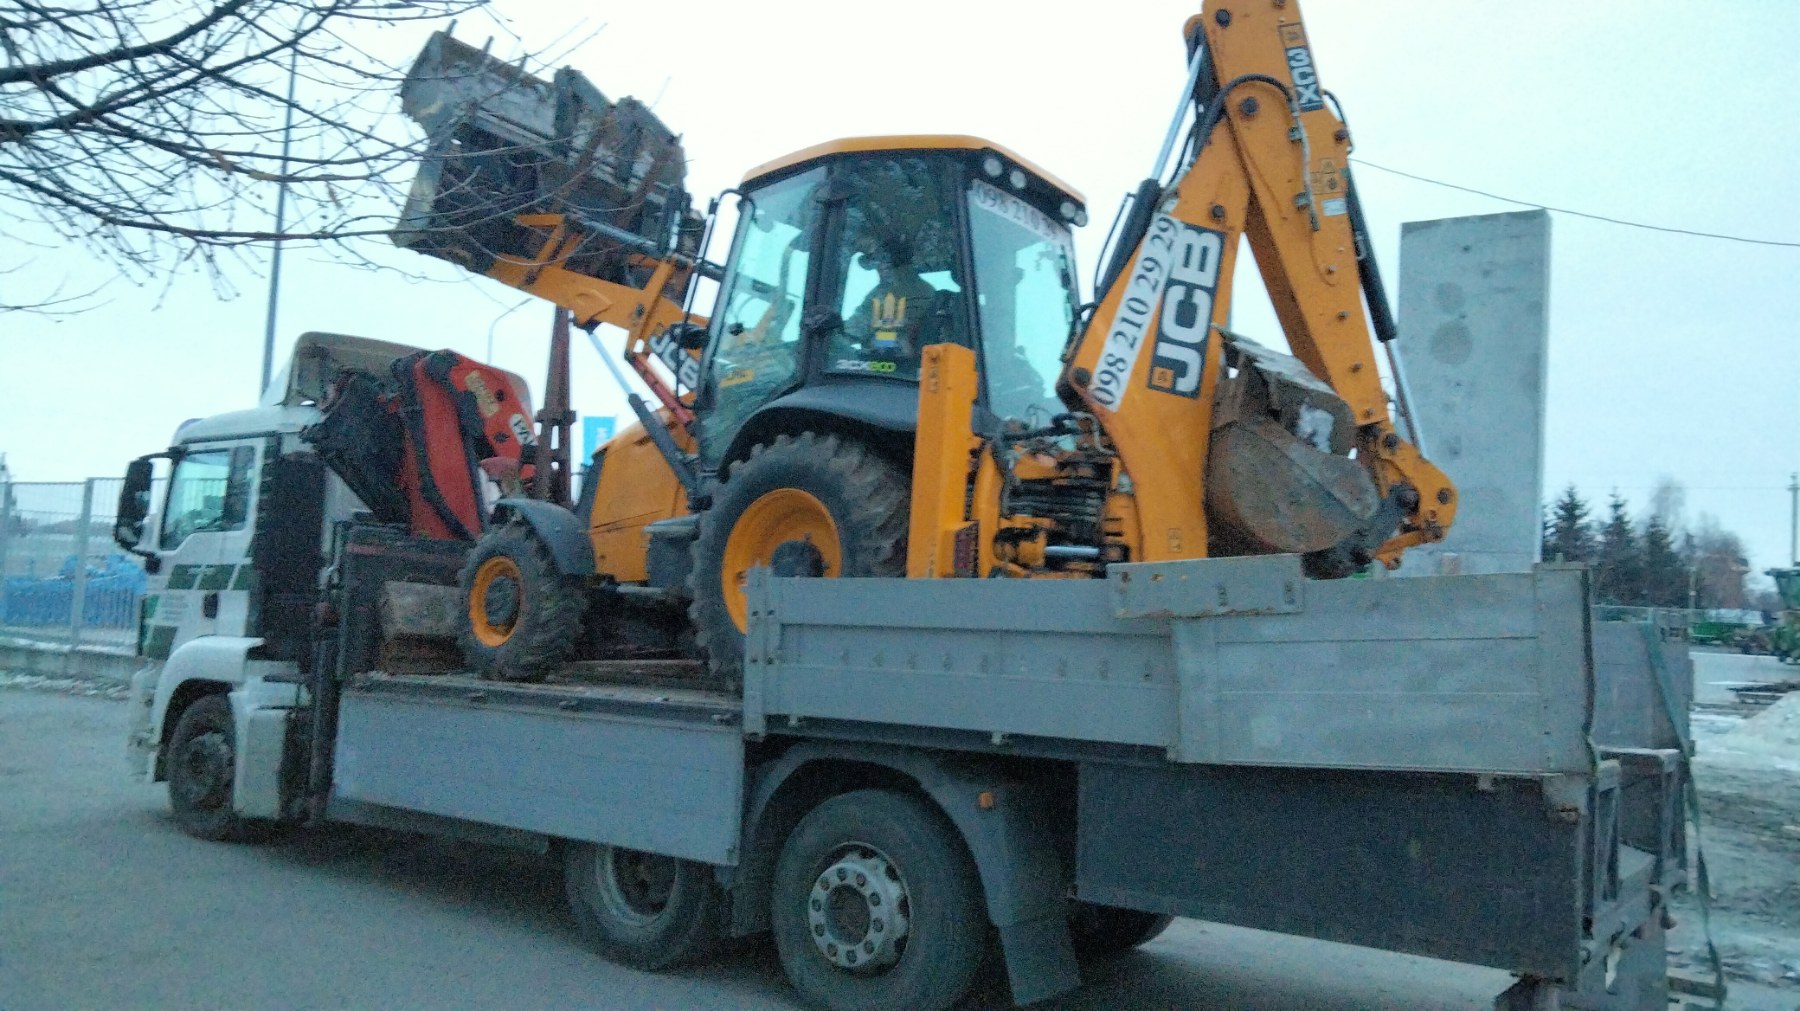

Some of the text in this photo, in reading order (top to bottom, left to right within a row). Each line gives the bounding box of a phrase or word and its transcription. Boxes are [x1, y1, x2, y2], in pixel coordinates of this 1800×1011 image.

[1287, 48, 1322, 104] 3CX
[1092, 216, 1178, 405] 098 210 29 29
[1156, 229, 1221, 393] JCB
